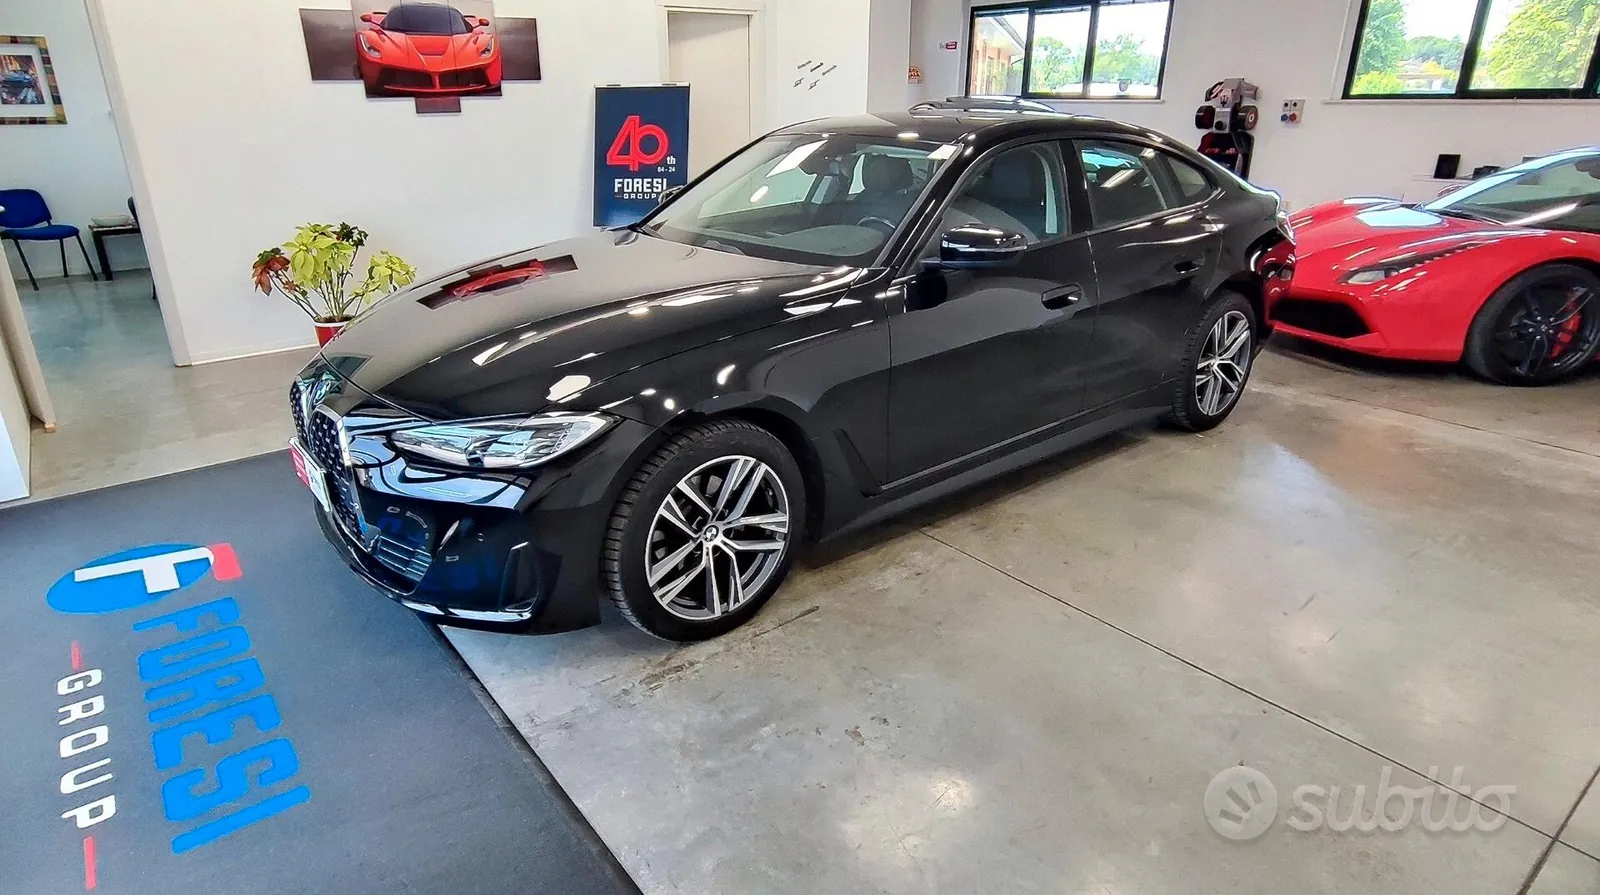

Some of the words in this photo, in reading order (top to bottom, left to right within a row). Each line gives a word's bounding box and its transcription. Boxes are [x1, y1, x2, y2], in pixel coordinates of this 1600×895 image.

[614, 178, 667, 192] FORESI
[57, 668, 116, 829] GROUP
[132, 597, 311, 854] FORESI
